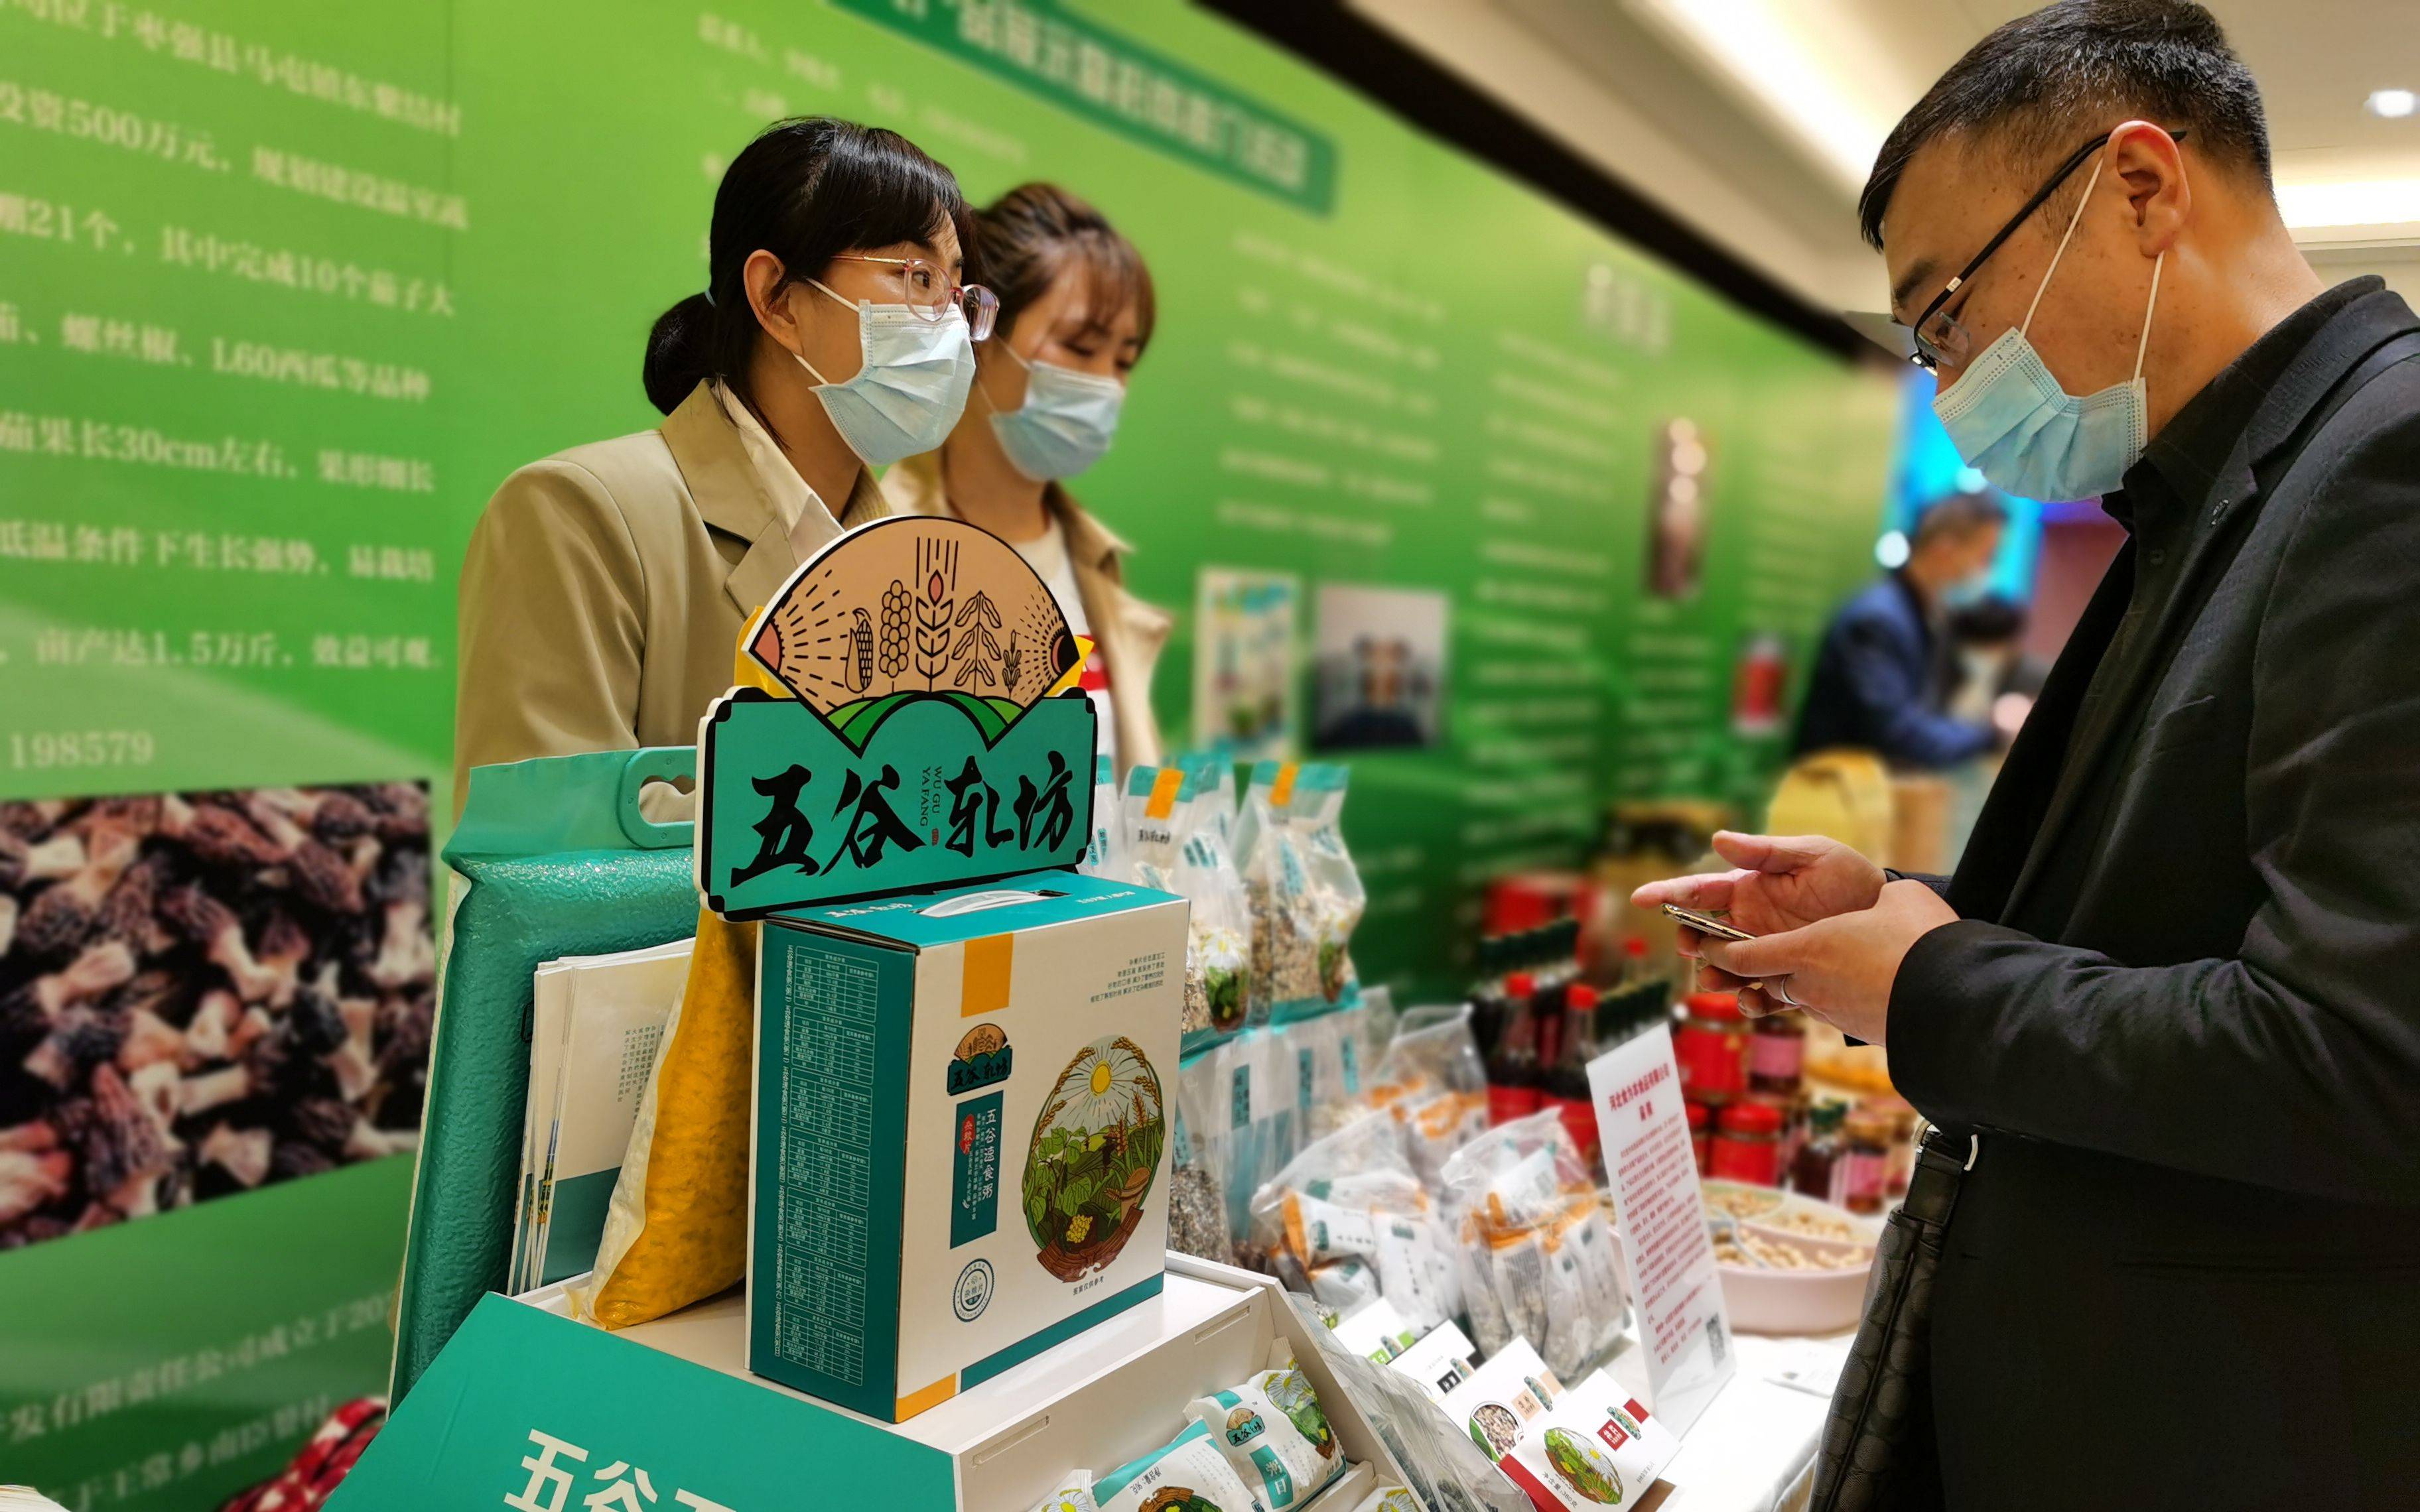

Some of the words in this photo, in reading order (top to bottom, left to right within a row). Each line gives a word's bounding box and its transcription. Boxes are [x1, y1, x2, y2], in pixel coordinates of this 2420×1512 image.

[9, 733, 155, 770] 198579
[921, 766, 931, 786] YA
[933, 766, 942, 789] WU
[920, 788, 929, 826] FANG
[932, 793, 940, 814] GU
